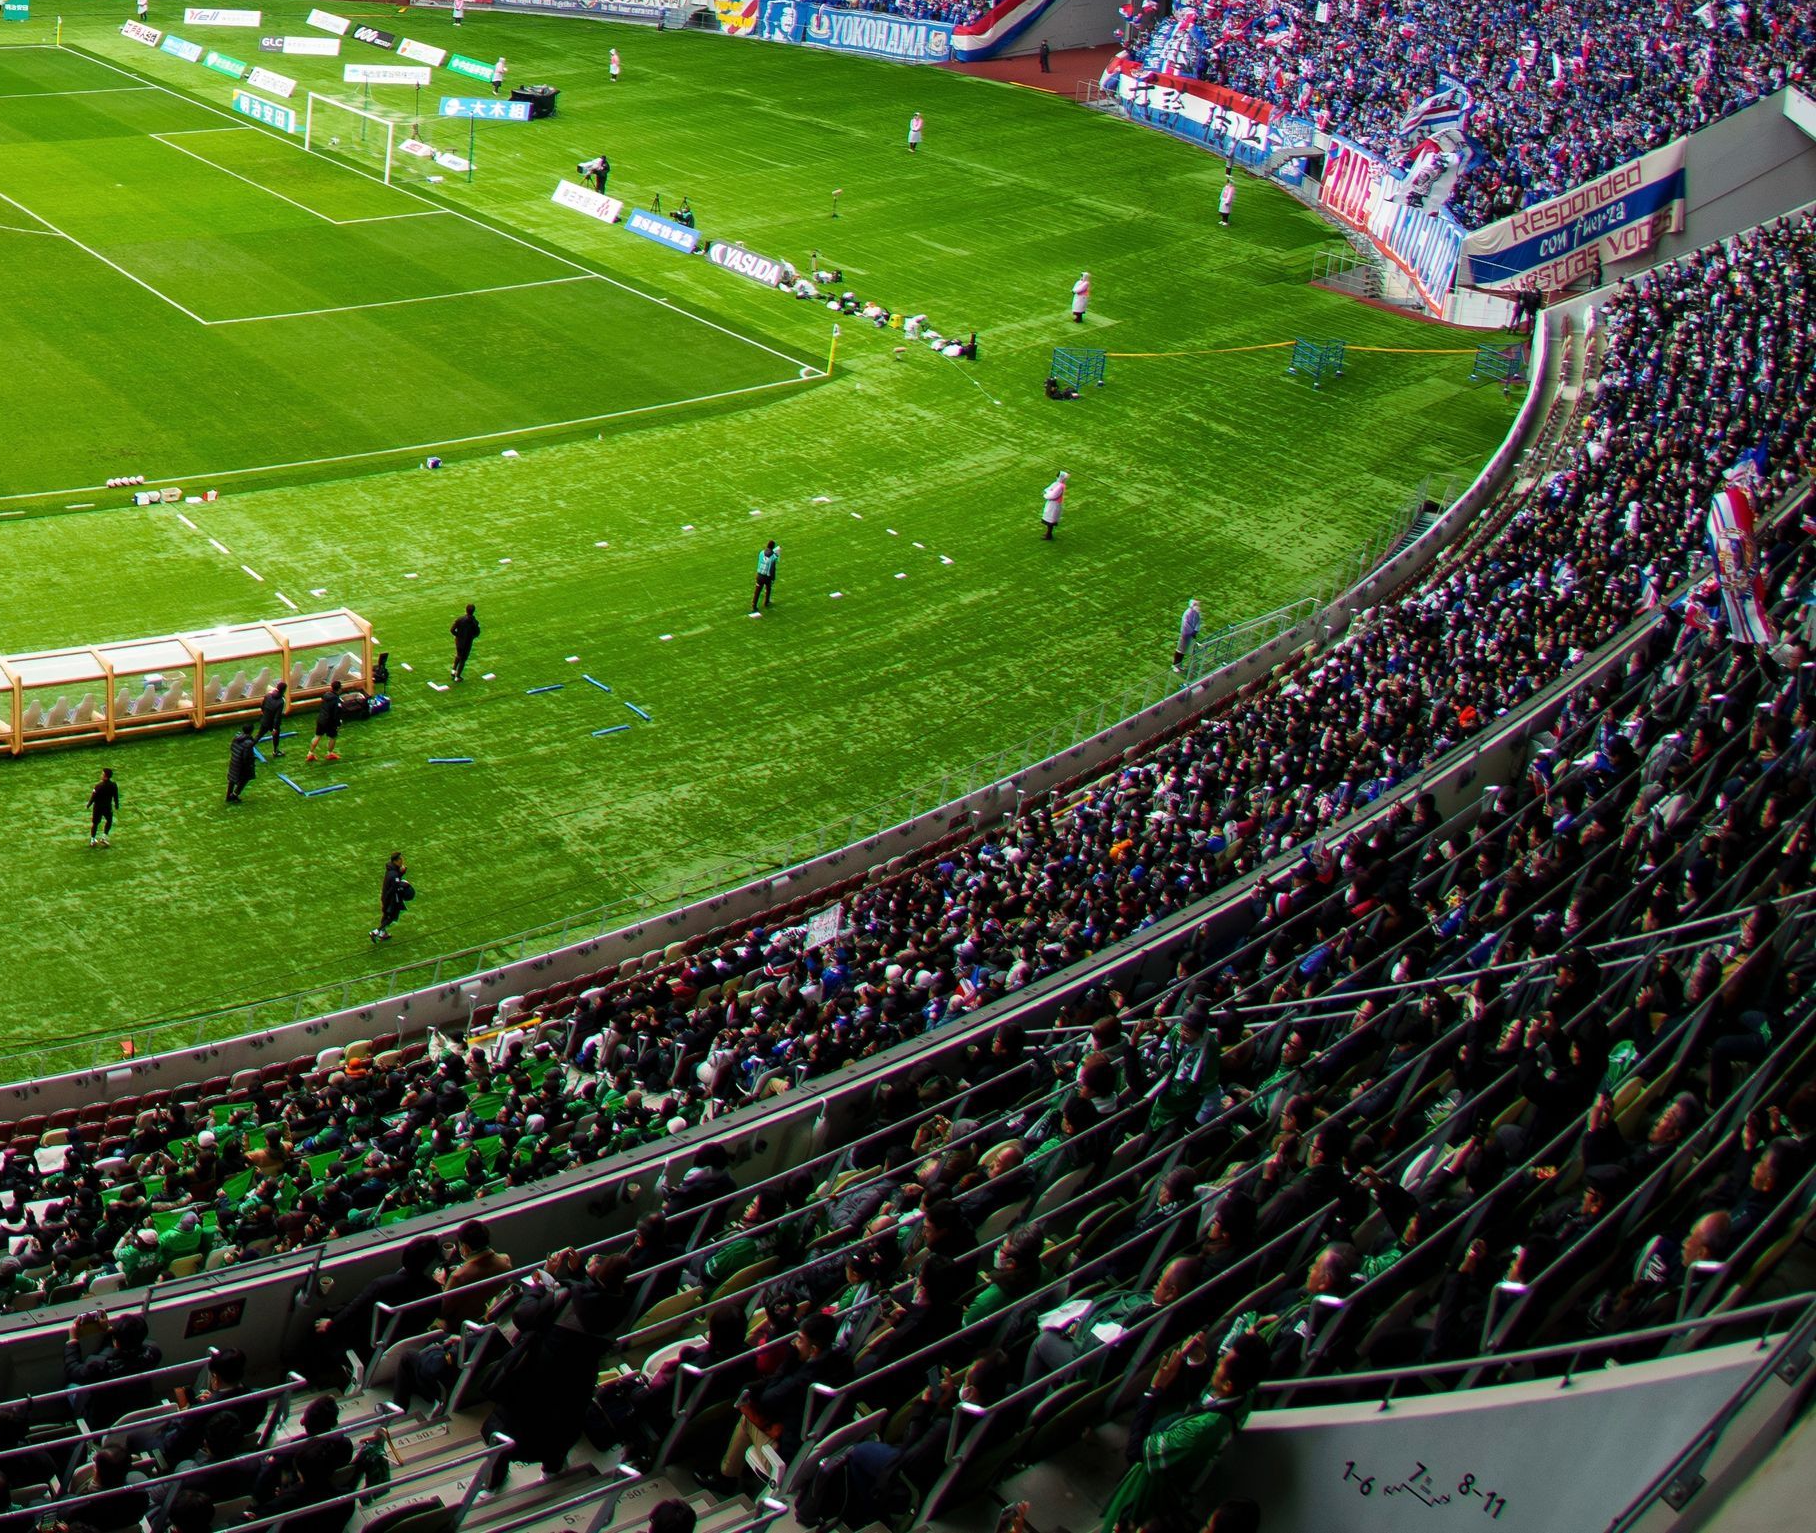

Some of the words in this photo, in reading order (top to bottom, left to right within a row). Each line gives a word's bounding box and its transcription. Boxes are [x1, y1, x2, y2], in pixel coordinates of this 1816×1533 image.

[262, 38, 283, 47] GLC
[831, 15, 925, 55] YOKOHAMA
[240, 96, 285, 125] 明治安田
[471, 100, 526, 118] 大木組
[1511, 164, 1643, 242] Responded
[1538, 228, 1569, 258] con
[1570, 202, 1627, 247] fuerza
[721, 246, 781, 286] YASUDA
[1341, 1460, 1376, 1497] 1-6
[1457, 1472, 1508, 1519] 8-11
